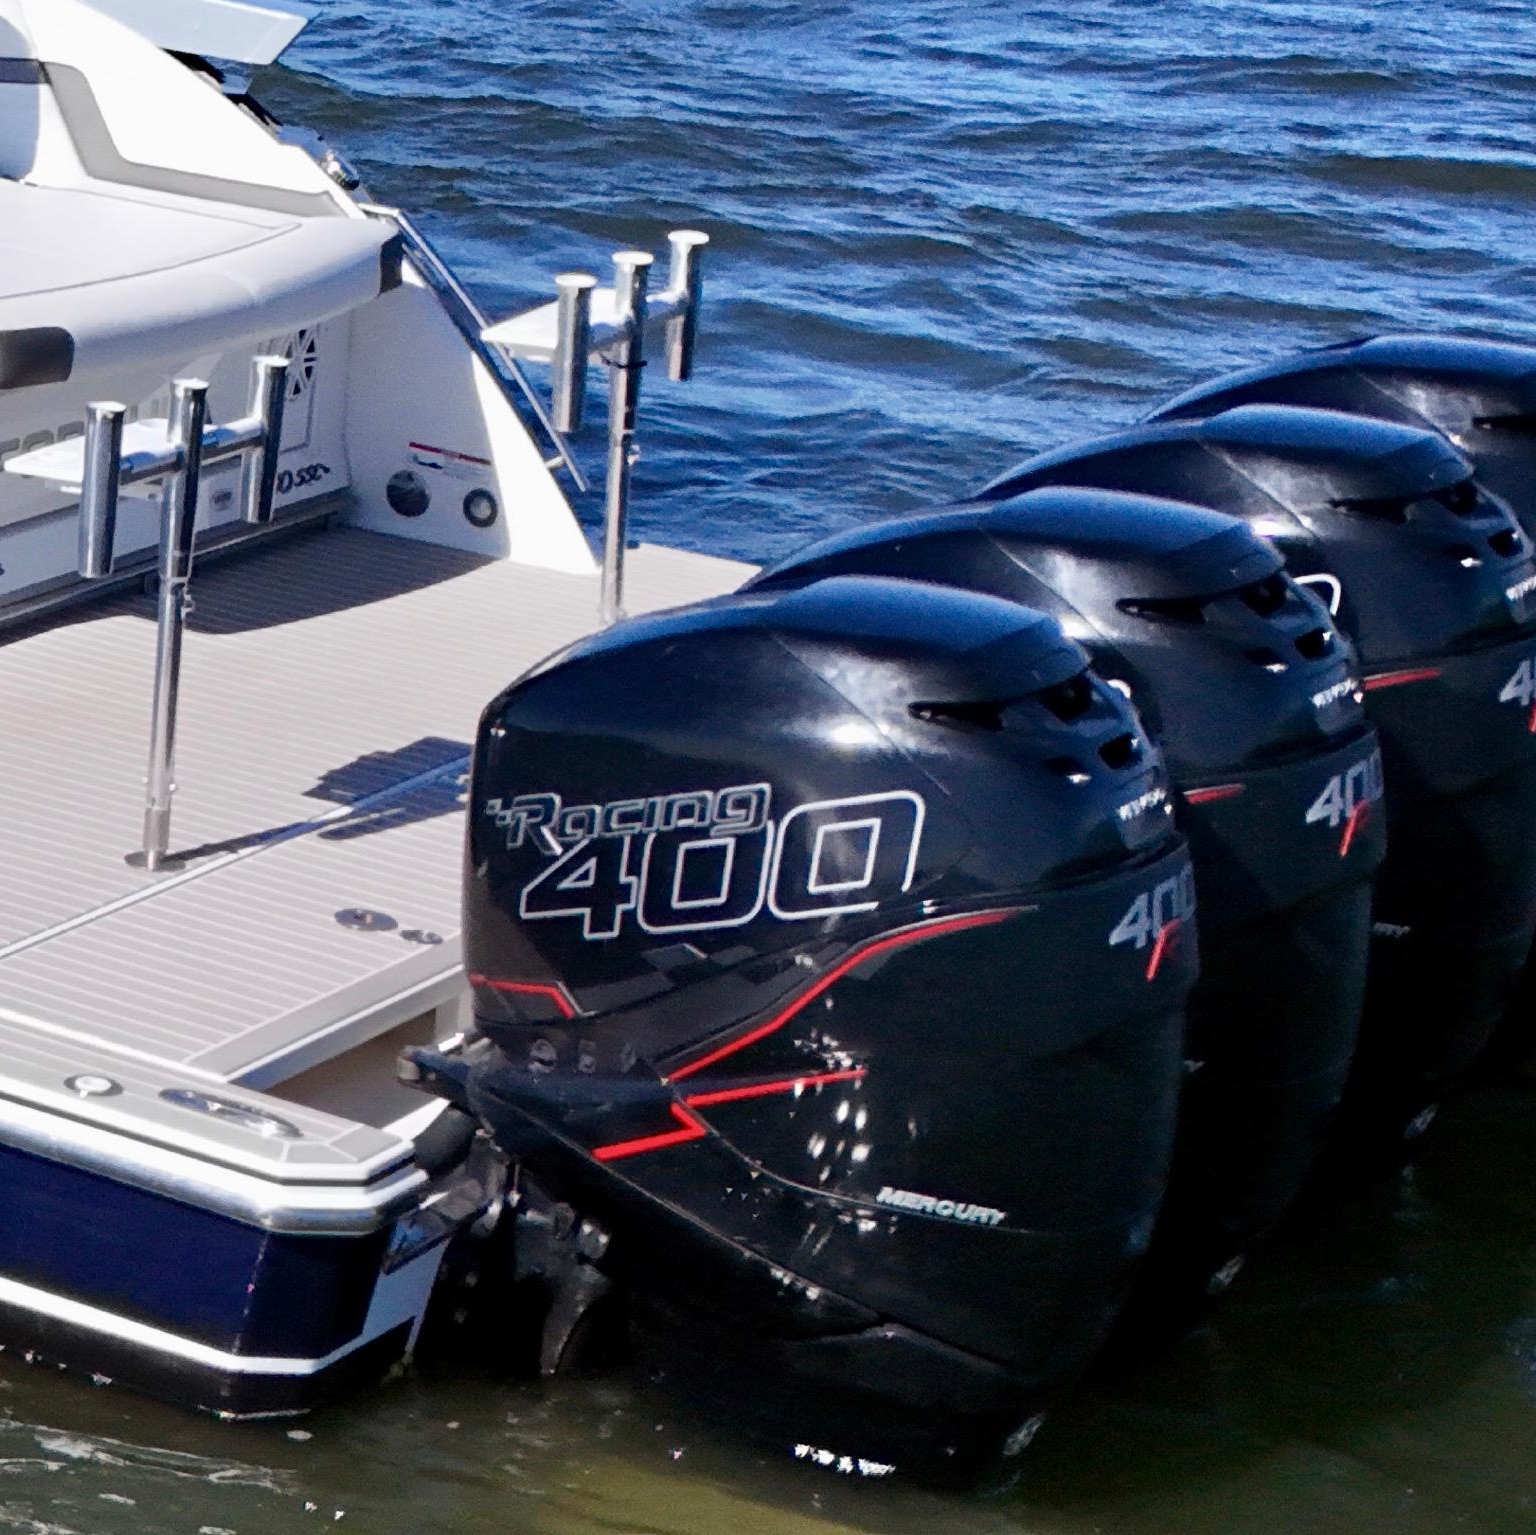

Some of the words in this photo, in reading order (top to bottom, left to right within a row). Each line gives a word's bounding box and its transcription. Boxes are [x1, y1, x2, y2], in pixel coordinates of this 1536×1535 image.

[499, 783, 771, 856] Racing
[520, 790, 926, 940] 400
[876, 1186, 1007, 1226] MERCURY
